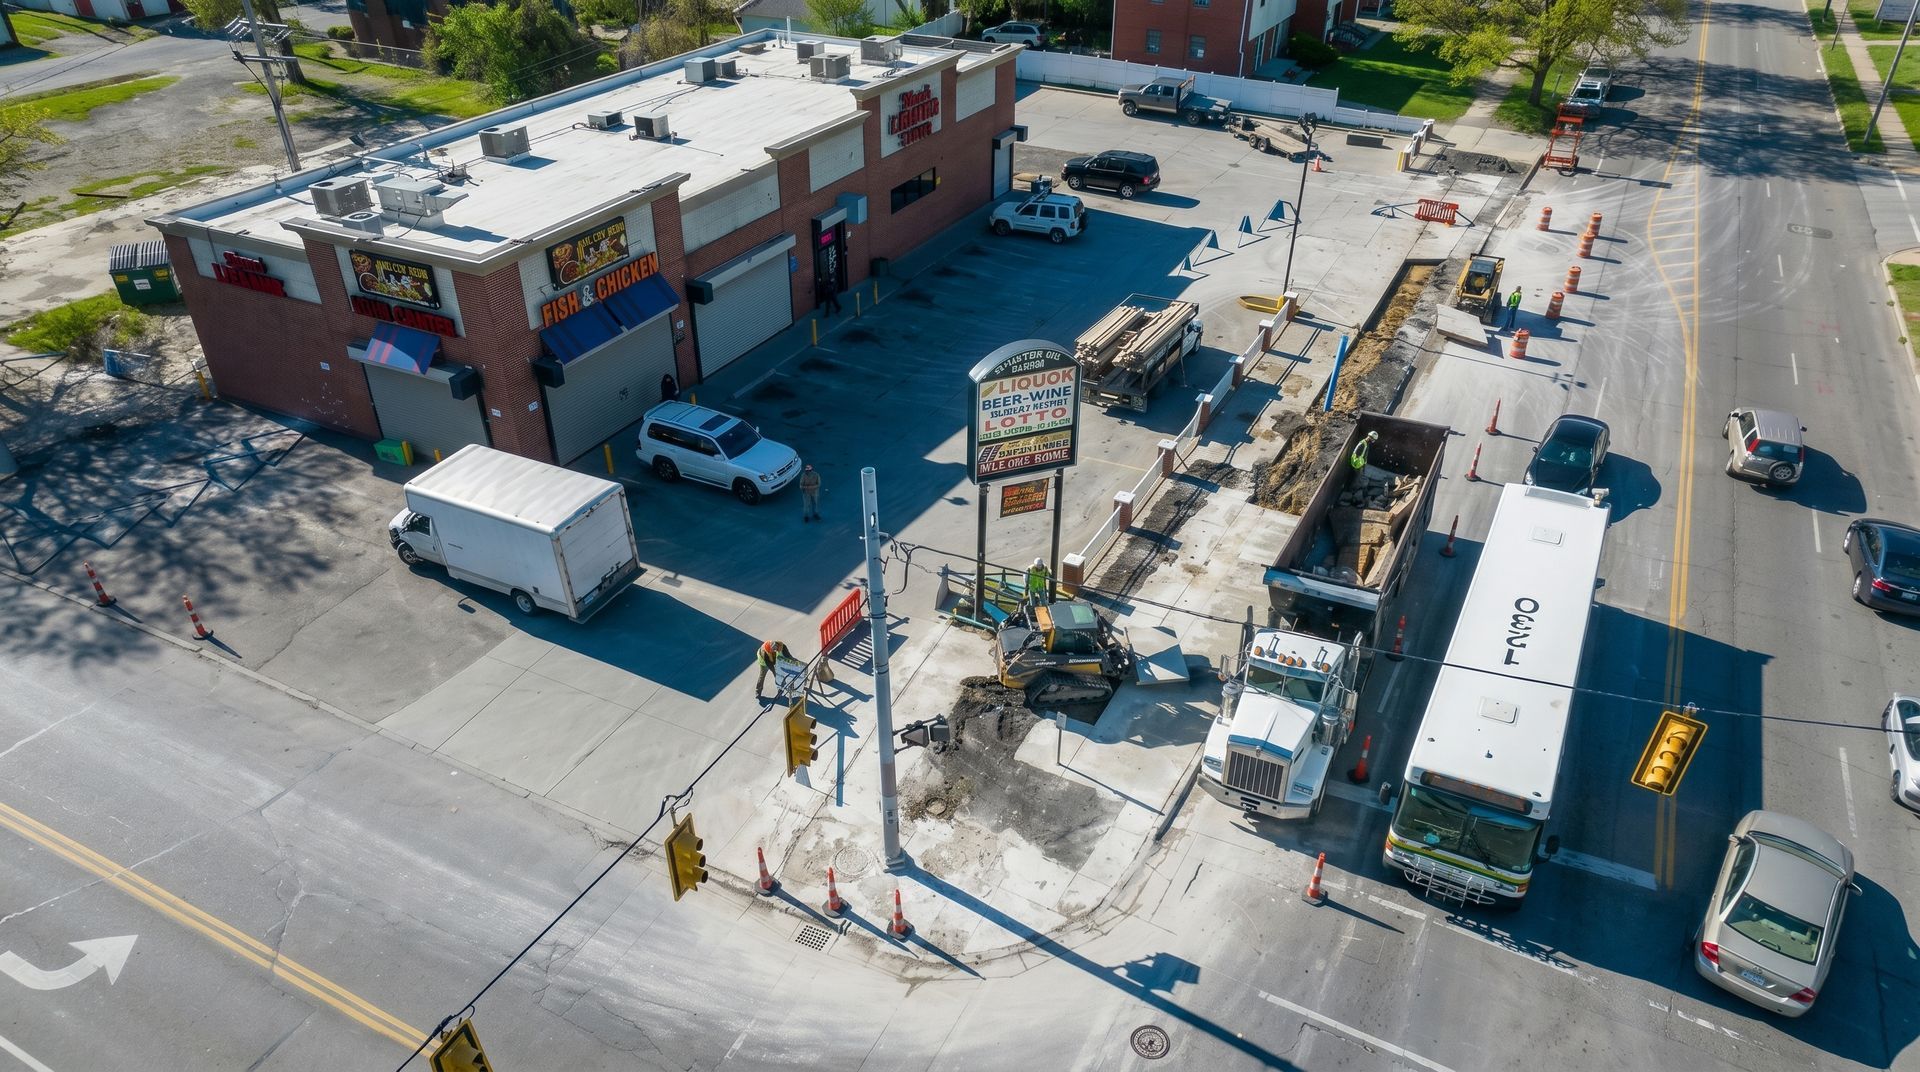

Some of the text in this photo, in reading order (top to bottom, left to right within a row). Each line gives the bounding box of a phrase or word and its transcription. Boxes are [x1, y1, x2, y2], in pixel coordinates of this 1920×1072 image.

[541, 251, 660, 328] FISH & CHICKEN
[982, 385, 1072, 411] BEER-WINE
[984, 407, 1067, 432] LOTTO
